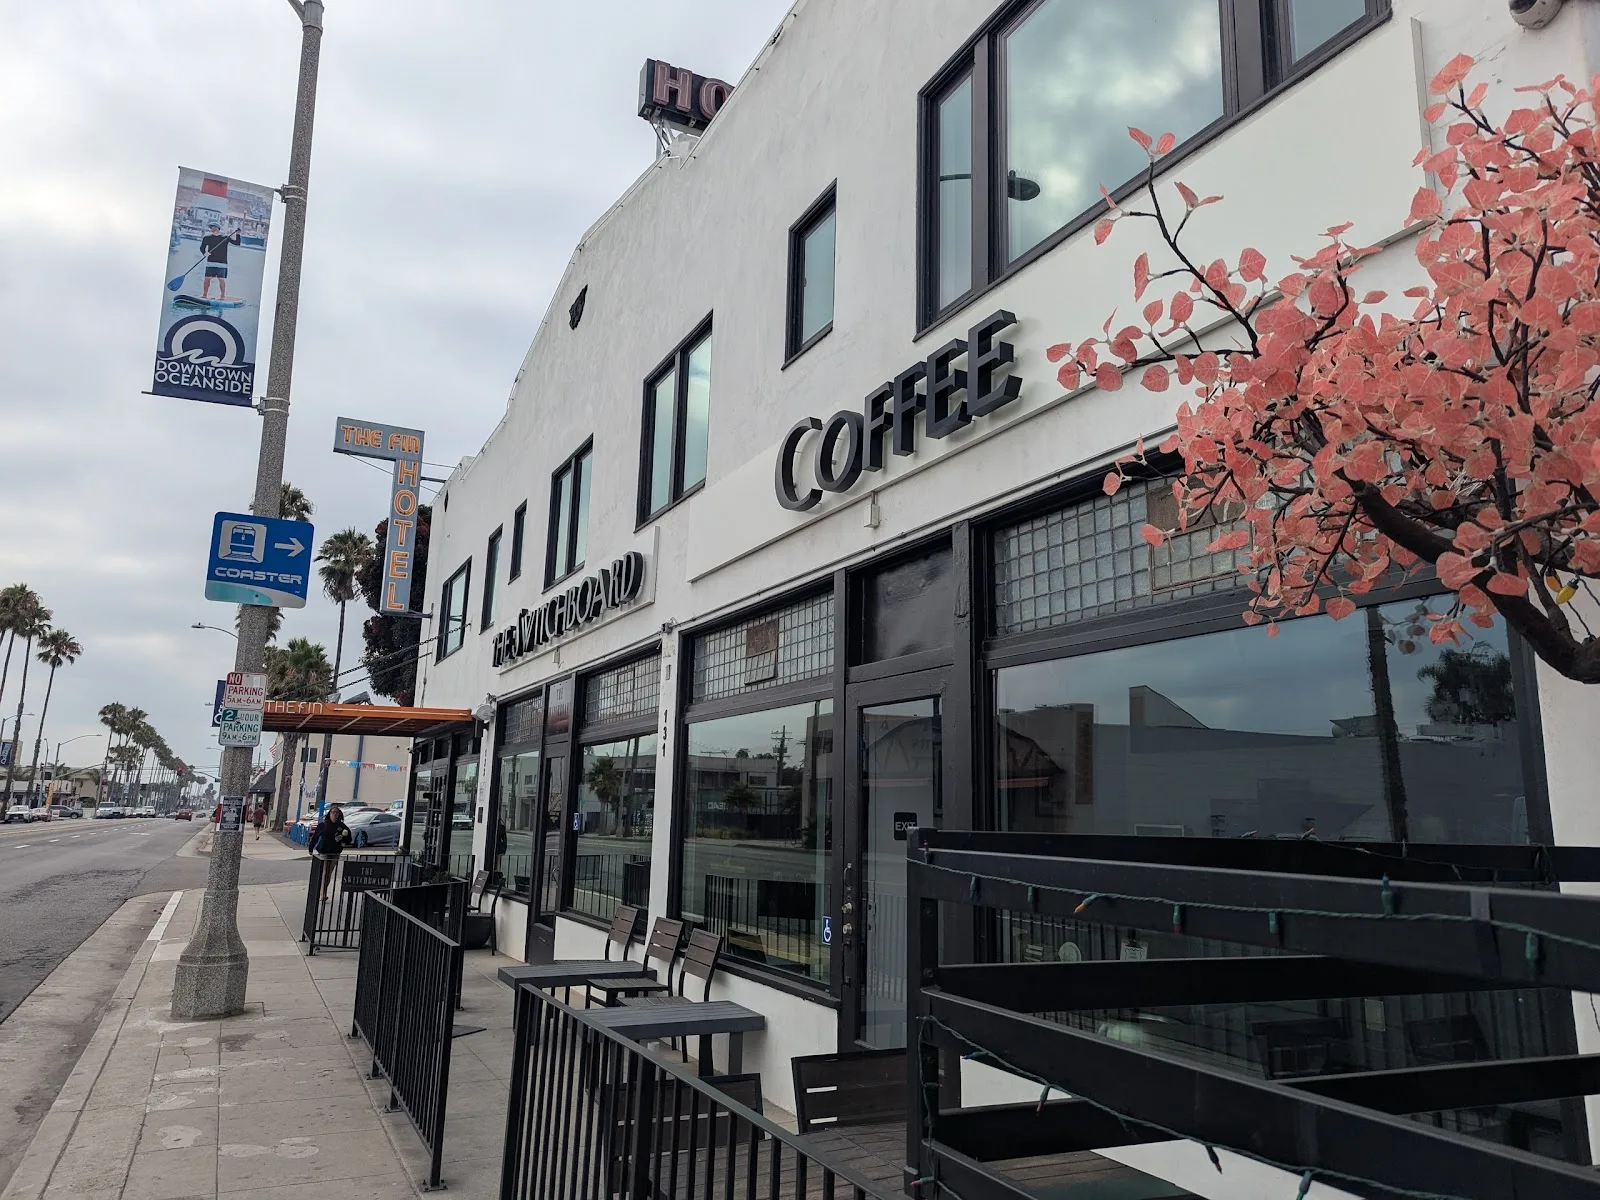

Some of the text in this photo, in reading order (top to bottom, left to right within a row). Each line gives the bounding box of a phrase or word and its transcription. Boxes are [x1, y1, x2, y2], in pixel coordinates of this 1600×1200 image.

[652, 60, 735, 120] HO
[156, 360, 252, 383] DOWNTOWN
[154, 371, 252, 394] OCEANSIDE
[774, 308, 1023, 512] COFFEE
[340, 424, 383, 449] THE
[387, 459, 419, 610] HOTEL
[214, 566, 303, 585] COASTER
[491, 550, 644, 668] THE SWITCHBOARD
[228, 673, 242, 685] NO
[228, 686, 264, 696] PARKING
[224, 710, 234, 721] 2
[264, 700, 297, 714] THE
[223, 723, 259, 733] PARKING
[895, 821, 915, 831] EXIT
